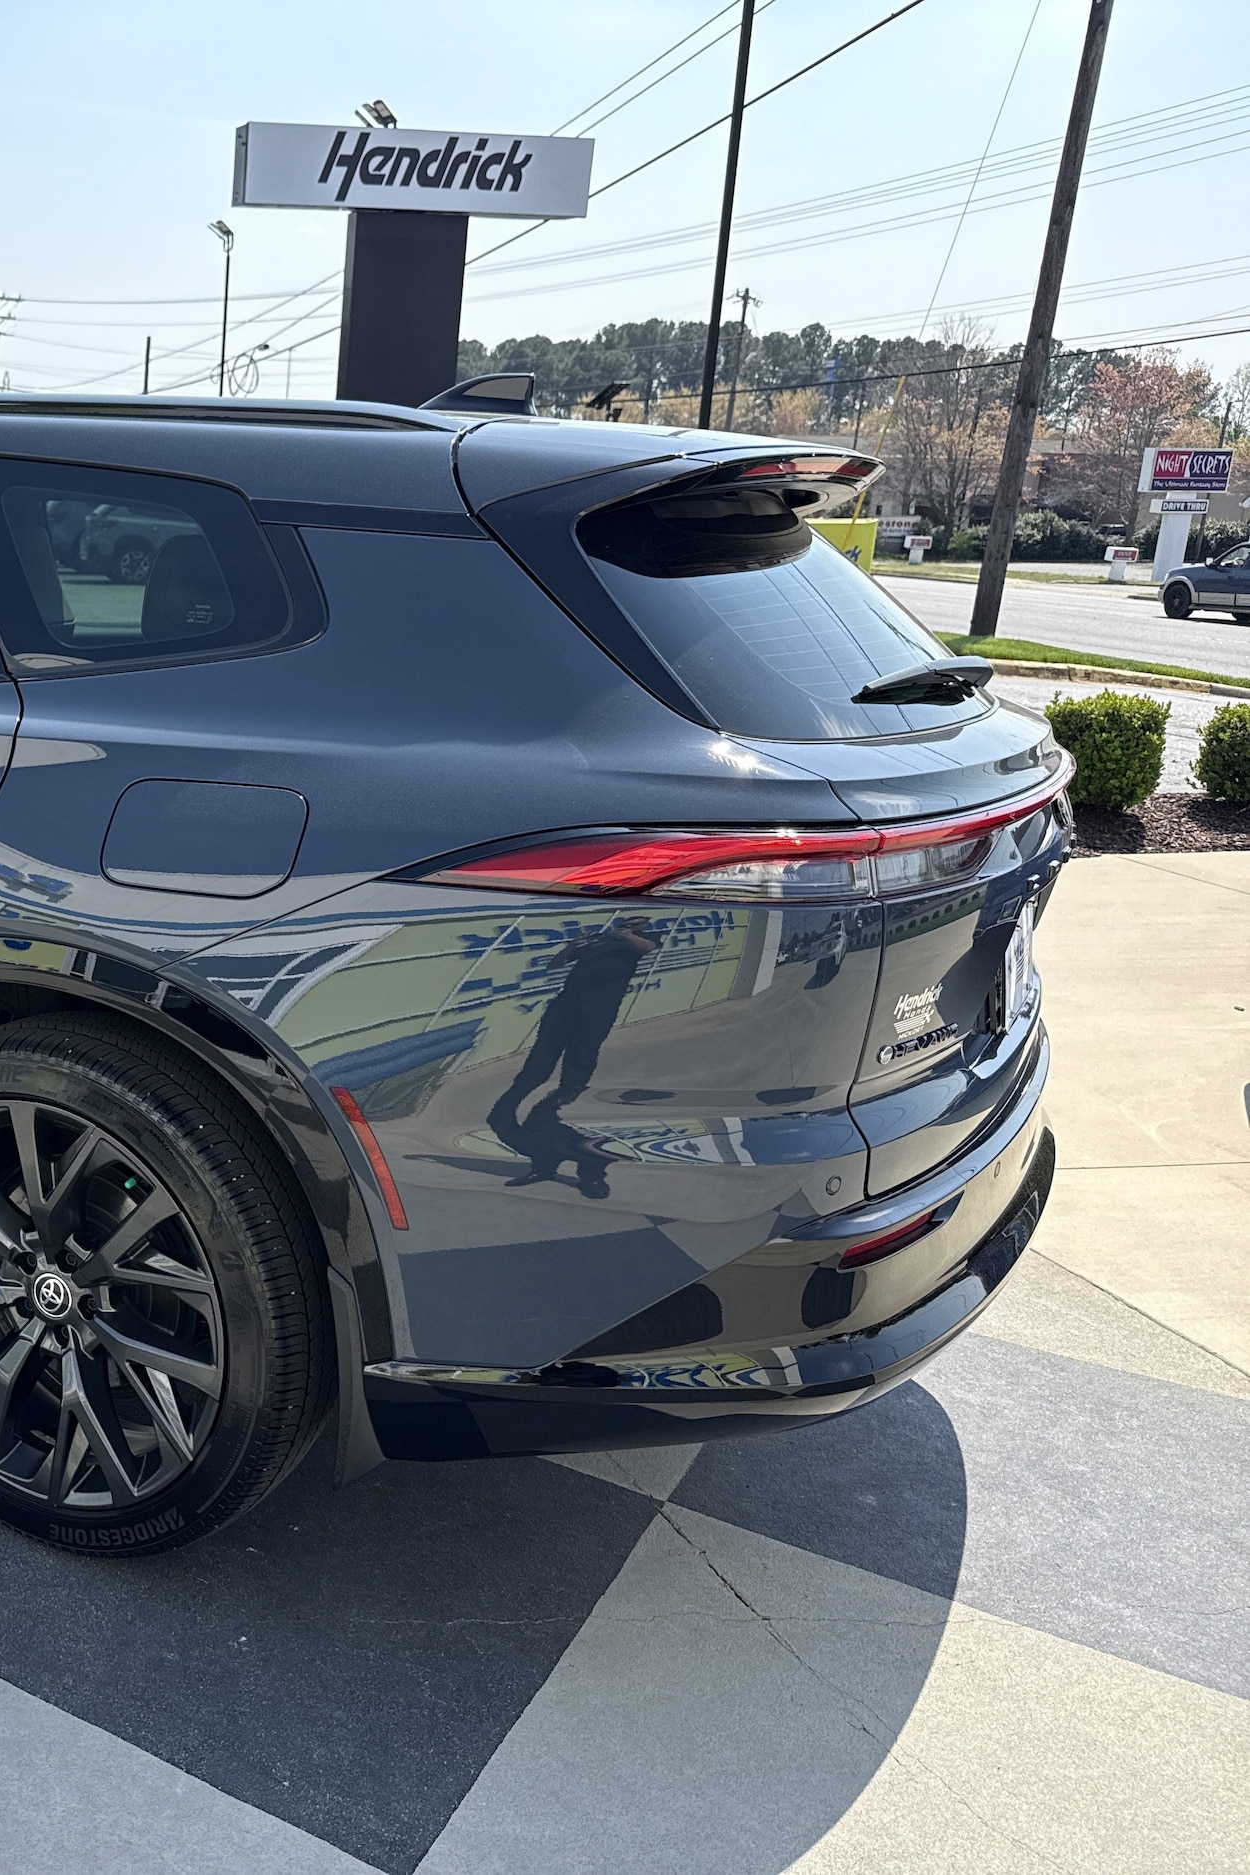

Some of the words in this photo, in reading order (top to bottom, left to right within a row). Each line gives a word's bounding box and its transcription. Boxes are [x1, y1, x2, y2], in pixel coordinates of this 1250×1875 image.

[317, 130, 533, 203] Hendrick
[1156, 454, 1189, 473] NIGHT
[1192, 454, 1232, 475] SECRETS
[1162, 502, 1185, 511] DRIVE
[1187, 502, 1207, 511] THRU
[893, 982, 944, 1020] Hendrick
[903, 1005, 932, 1020] Honda
[897, 1025, 925, 1040] HICKORY
[48, 1506, 186, 1547] BRIDGESTONE
